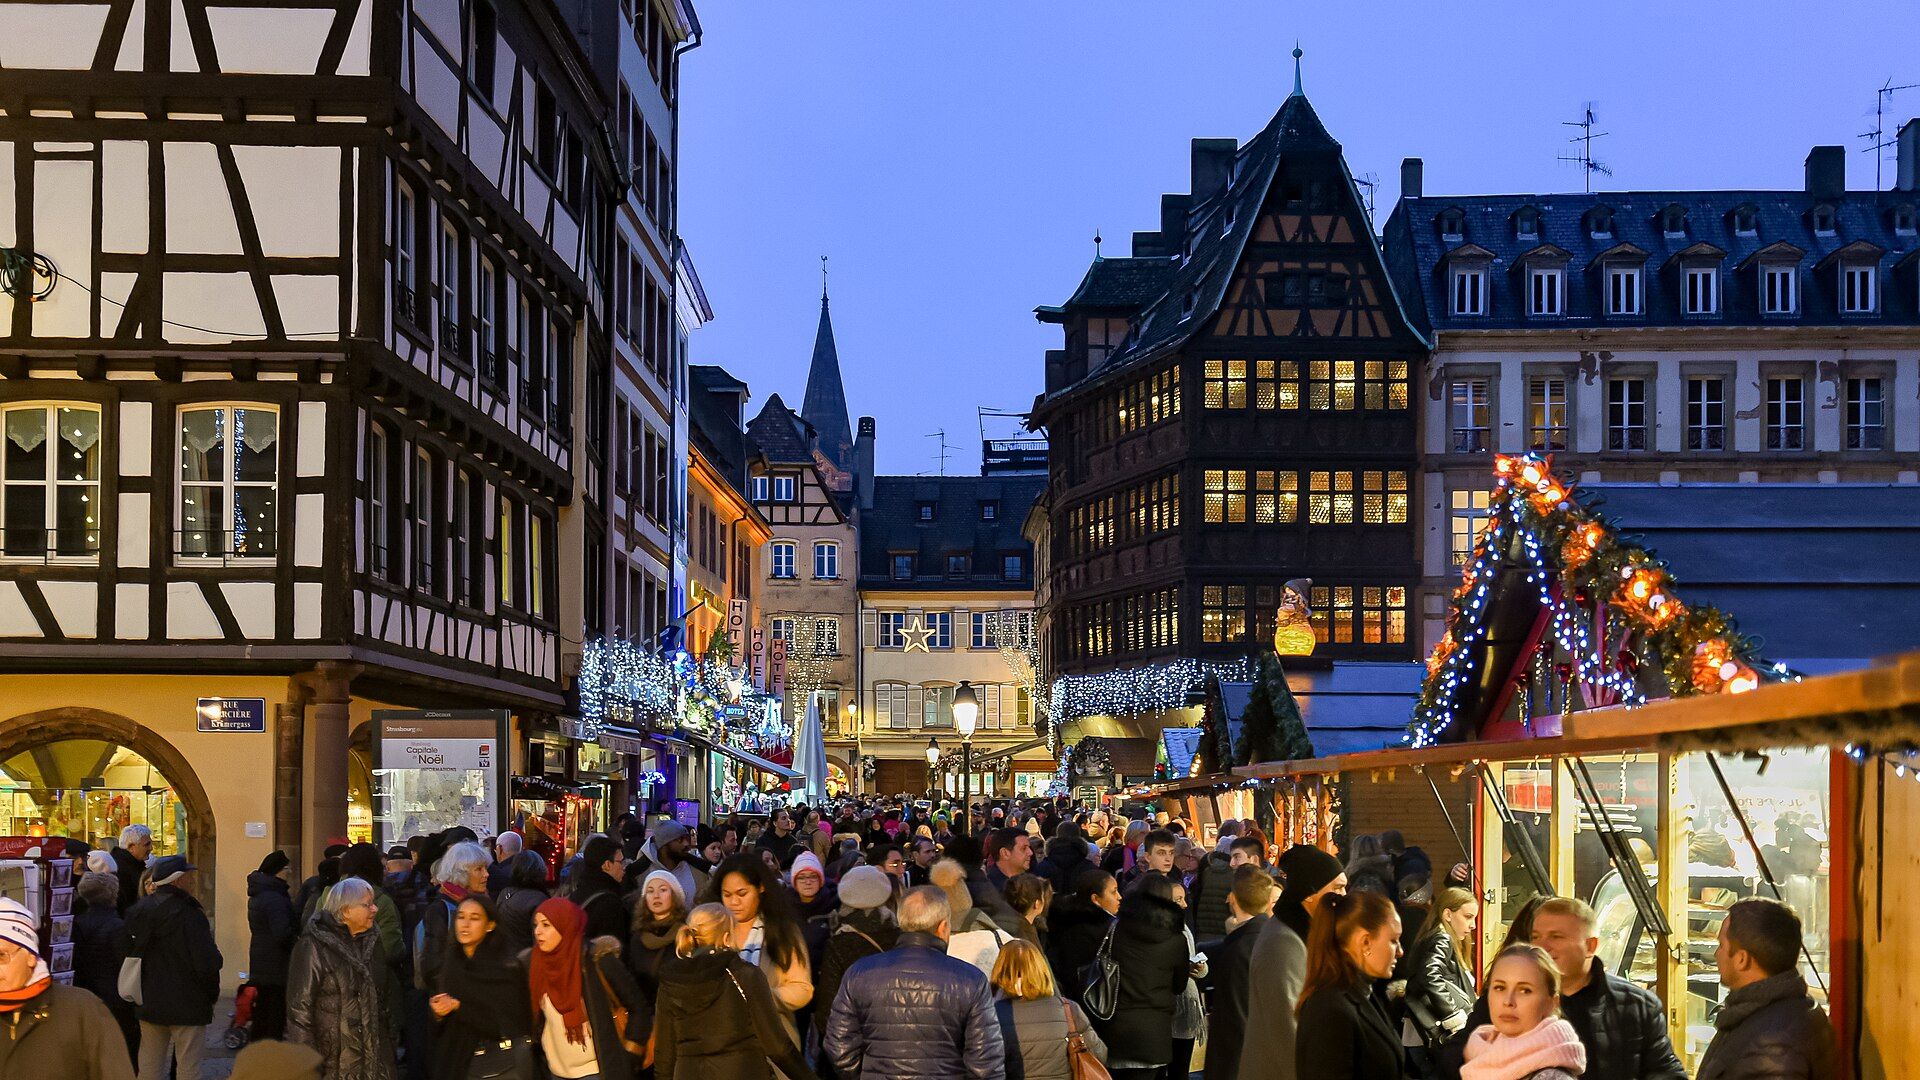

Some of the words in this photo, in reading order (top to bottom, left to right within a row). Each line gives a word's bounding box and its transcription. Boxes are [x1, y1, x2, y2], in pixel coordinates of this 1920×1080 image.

[730, 601, 743, 667] HOTEL
[753, 629, 763, 689] HOTEL
[223, 701, 239, 709] RUE
[726, 707, 745, 716] HOTEL
[406, 746, 438, 755] Capitale
[418, 754, 444, 765] Noël
